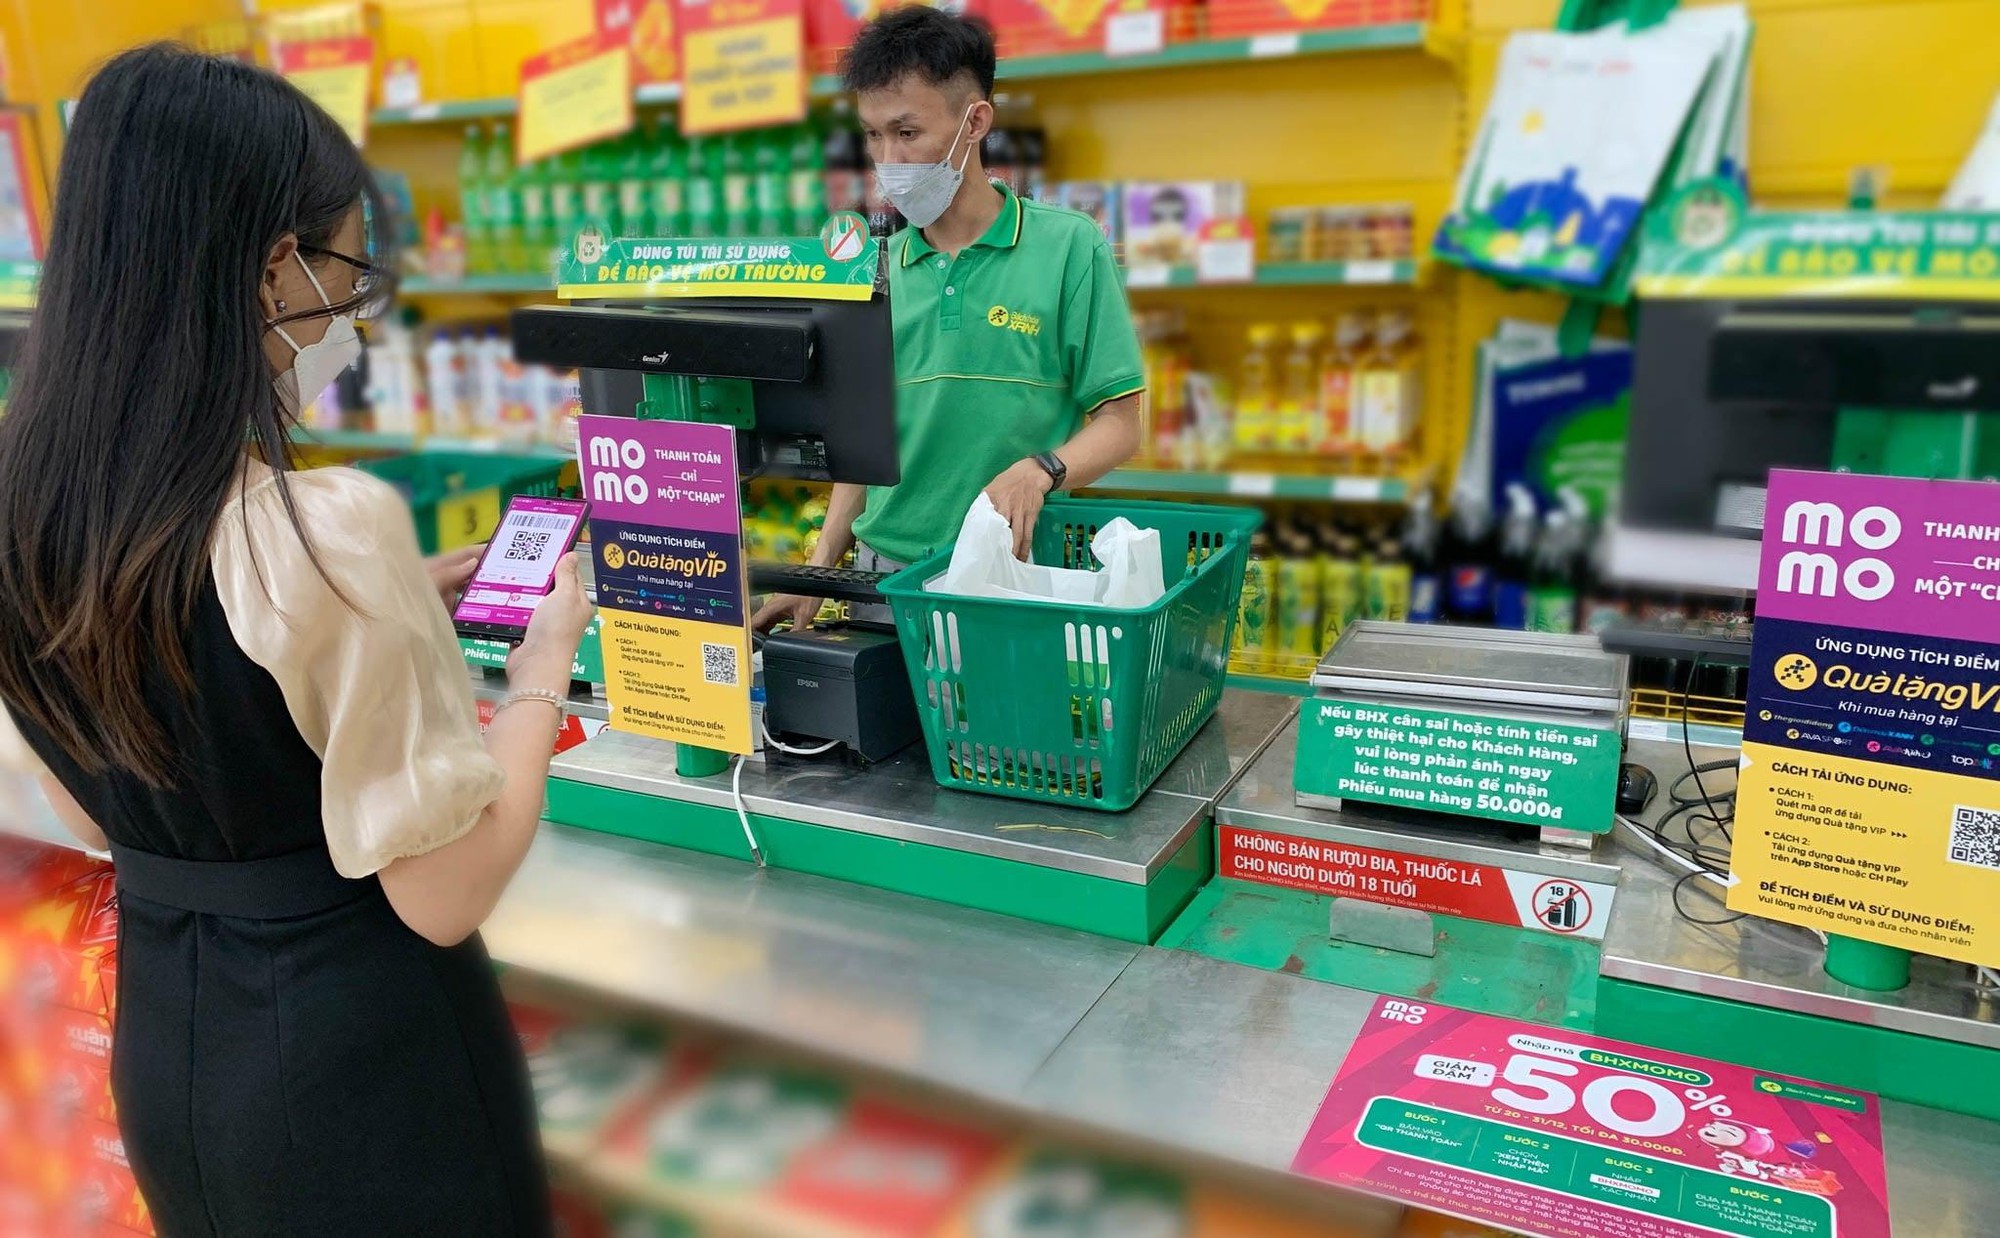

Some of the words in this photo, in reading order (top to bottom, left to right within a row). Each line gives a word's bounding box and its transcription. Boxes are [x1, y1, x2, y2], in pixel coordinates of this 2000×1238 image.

[633, 245, 673, 260] DÙNG
[676, 244, 697, 259] TÚI
[726, 244, 744, 259] SỬ
[748, 244, 791, 261] DỤNG
[598, 259, 621, 281] ĐỂ
[744, 261, 827, 281] TRƯỜNG
[1008, 320, 1040, 336] XANH
[654, 448, 690, 462] THANH
[692, 450, 722, 465] TOÁN
[680, 468, 698, 482] CHỈ
[658, 486, 682, 502] MỘT
[620, 530, 638, 541] ỨNG
[638, 534, 662, 545] DỤNG
[663, 536, 683, 547] TÍCH
[684, 537, 706, 550] ĐIỂM
[1923, 522, 2000, 542] THANH
[1973, 556, 2000, 571] CH
[638, 575, 649, 583] Khi
[650, 578, 665, 586] mua
[666, 578, 683, 589] hàng
[684, 580, 694, 589] tại
[1914, 575, 1967, 600] MỘT
[464, 648, 490, 660] Phiếu
[492, 653, 507, 662] mu
[1815, 636, 1853, 654] ỨNG
[1856, 644, 1905, 661] DỤNG
[1909, 648, 1950, 666] TÍCH
[1954, 653, 2000, 672] ĐIỂM
[797, 678, 819, 688] EPSON
[1839, 700, 1862, 714] Khi
[1864, 705, 1896, 718] mua
[1899, 708, 1936, 726] hàng
[1939, 714, 1959, 728] tại
[1320, 704, 1351, 720] Nếu
[1355, 710, 1389, 724] BHX
[1392, 713, 1422, 727] cân
[1426, 717, 1449, 731] sai
[1452, 721, 1493, 737] hoặc
[1496, 726, 1531, 740] tính
[1535, 729, 1568, 744] tiền
[1573, 734, 1598, 748] sai
[1334, 724, 1364, 740] gây
[1367, 727, 1406, 744] thiệt
[1409, 732, 1435, 747] hại
[1437, 736, 1468, 750] cho
[1472, 740, 1524, 757] Khách
[1528, 745, 1579, 765] Hàng,
[1355, 744, 1381, 759] vui
[1384, 746, 1421, 766] lòng
[1424, 753, 1468, 774] phản
[1471, 757, 1504, 774] ánh
[1508, 764, 1553, 782] ngay
[1354, 762, 1380, 777] lúc
[1383, 766, 1432, 783] thanh
[1436, 771, 1474, 788] toán
[1478, 776, 1501, 792] để
[1504, 780, 1549, 799] nhận
[1772, 762, 1808, 777] CÁCH
[1812, 768, 1832, 781] TẢI
[1835, 771, 1865, 786] ỨNG
[1868, 778, 1913, 794] DỤNG:
[1339, 778, 1385, 796] Phiếu
[1388, 787, 1425, 801] mua
[1429, 790, 1473, 810] hàng
[1476, 795, 1564, 820] 50.000đ
[1778, 787, 1805, 799] CÁCH
[1807, 793, 1814, 801] 1:
[1776, 798, 1799, 809] Quét
[1801, 803, 1816, 812] mã
[1819, 806, 1833, 815] QR
[1835, 808, 1847, 818] để
[1849, 811, 1862, 820] tải
[1775, 808, 1794, 820] ứng
[1796, 812, 1821, 825] dụng
[1823, 818, 1843, 828] Quà
[1845, 821, 1868, 834] tặng
[1773, 831, 1800, 844] CÁCH
[1234, 834, 1286, 855] KHÔNG
[1289, 841, 1321, 860] BÁN
[1324, 848, 1368, 870] RƯỢU
[1370, 854, 1400, 876] BIA,
[1403, 857, 1459, 884] THUỐC
[1461, 867, 1483, 887] LÁ
[1772, 842, 1786, 852] Tải
[1787, 845, 1806, 857] ứng
[1808, 850, 1833, 862] dụng
[1835, 855, 1856, 866] Quà
[1858, 859, 1882, 873] tặng
[1884, 865, 1901, 874] VIP
[1234, 855, 1264, 873] CHO
[1267, 859, 1315, 882] NGƯỜI
[1319, 867, 1356, 889] DƯỚI
[1360, 875, 1379, 894] 18
[1381, 877, 1417, 899] TUỔI
[1771, 853, 1790, 863] trên
[1792, 858, 1812, 868] App
[1813, 861, 1841, 873] Store
[1842, 867, 1866, 879] hoặc
[1869, 872, 1884, 882] CH
[1886, 875, 1909, 888] Play
[1550, 886, 1564, 897] 18
[1760, 881, 1778, 893] ĐỂ
[1780, 884, 1809, 900] TÍCH
[1812, 891, 1846, 908] ĐIỂM
[1849, 898, 1866, 912] VÀ
[1869, 904, 1891, 917] SỬ
[1892, 909, 1932, 926] DỤNG
[1935, 918, 1975, 935] ĐIỂM:
[1517, 1038, 1551, 1051] Nhập
[1554, 1046, 1574, 1056] mã
[1432, 1069, 1472, 1081] ĐẬM
[1433, 1060, 1477, 1073] GIẢM
[1589, 1053, 1701, 1083] BHXMOMO
[1404, 1111, 1439, 1125] BƯỚC
[1484, 1104, 1502, 1115] TỪ
[1503, 1108, 1521, 1119] 20
[1532, 1115, 1568, 1132] 31/12,
[1572, 1123, 1597, 1135] TỐI
[1599, 1131, 1618, 1141] ĐA
[1504, 1134, 1540, 1148] BƯỚC
[1604, 1158, 1644, 1172] BƯỚC
[1730, 1186, 1772, 1202] BƯỚC
